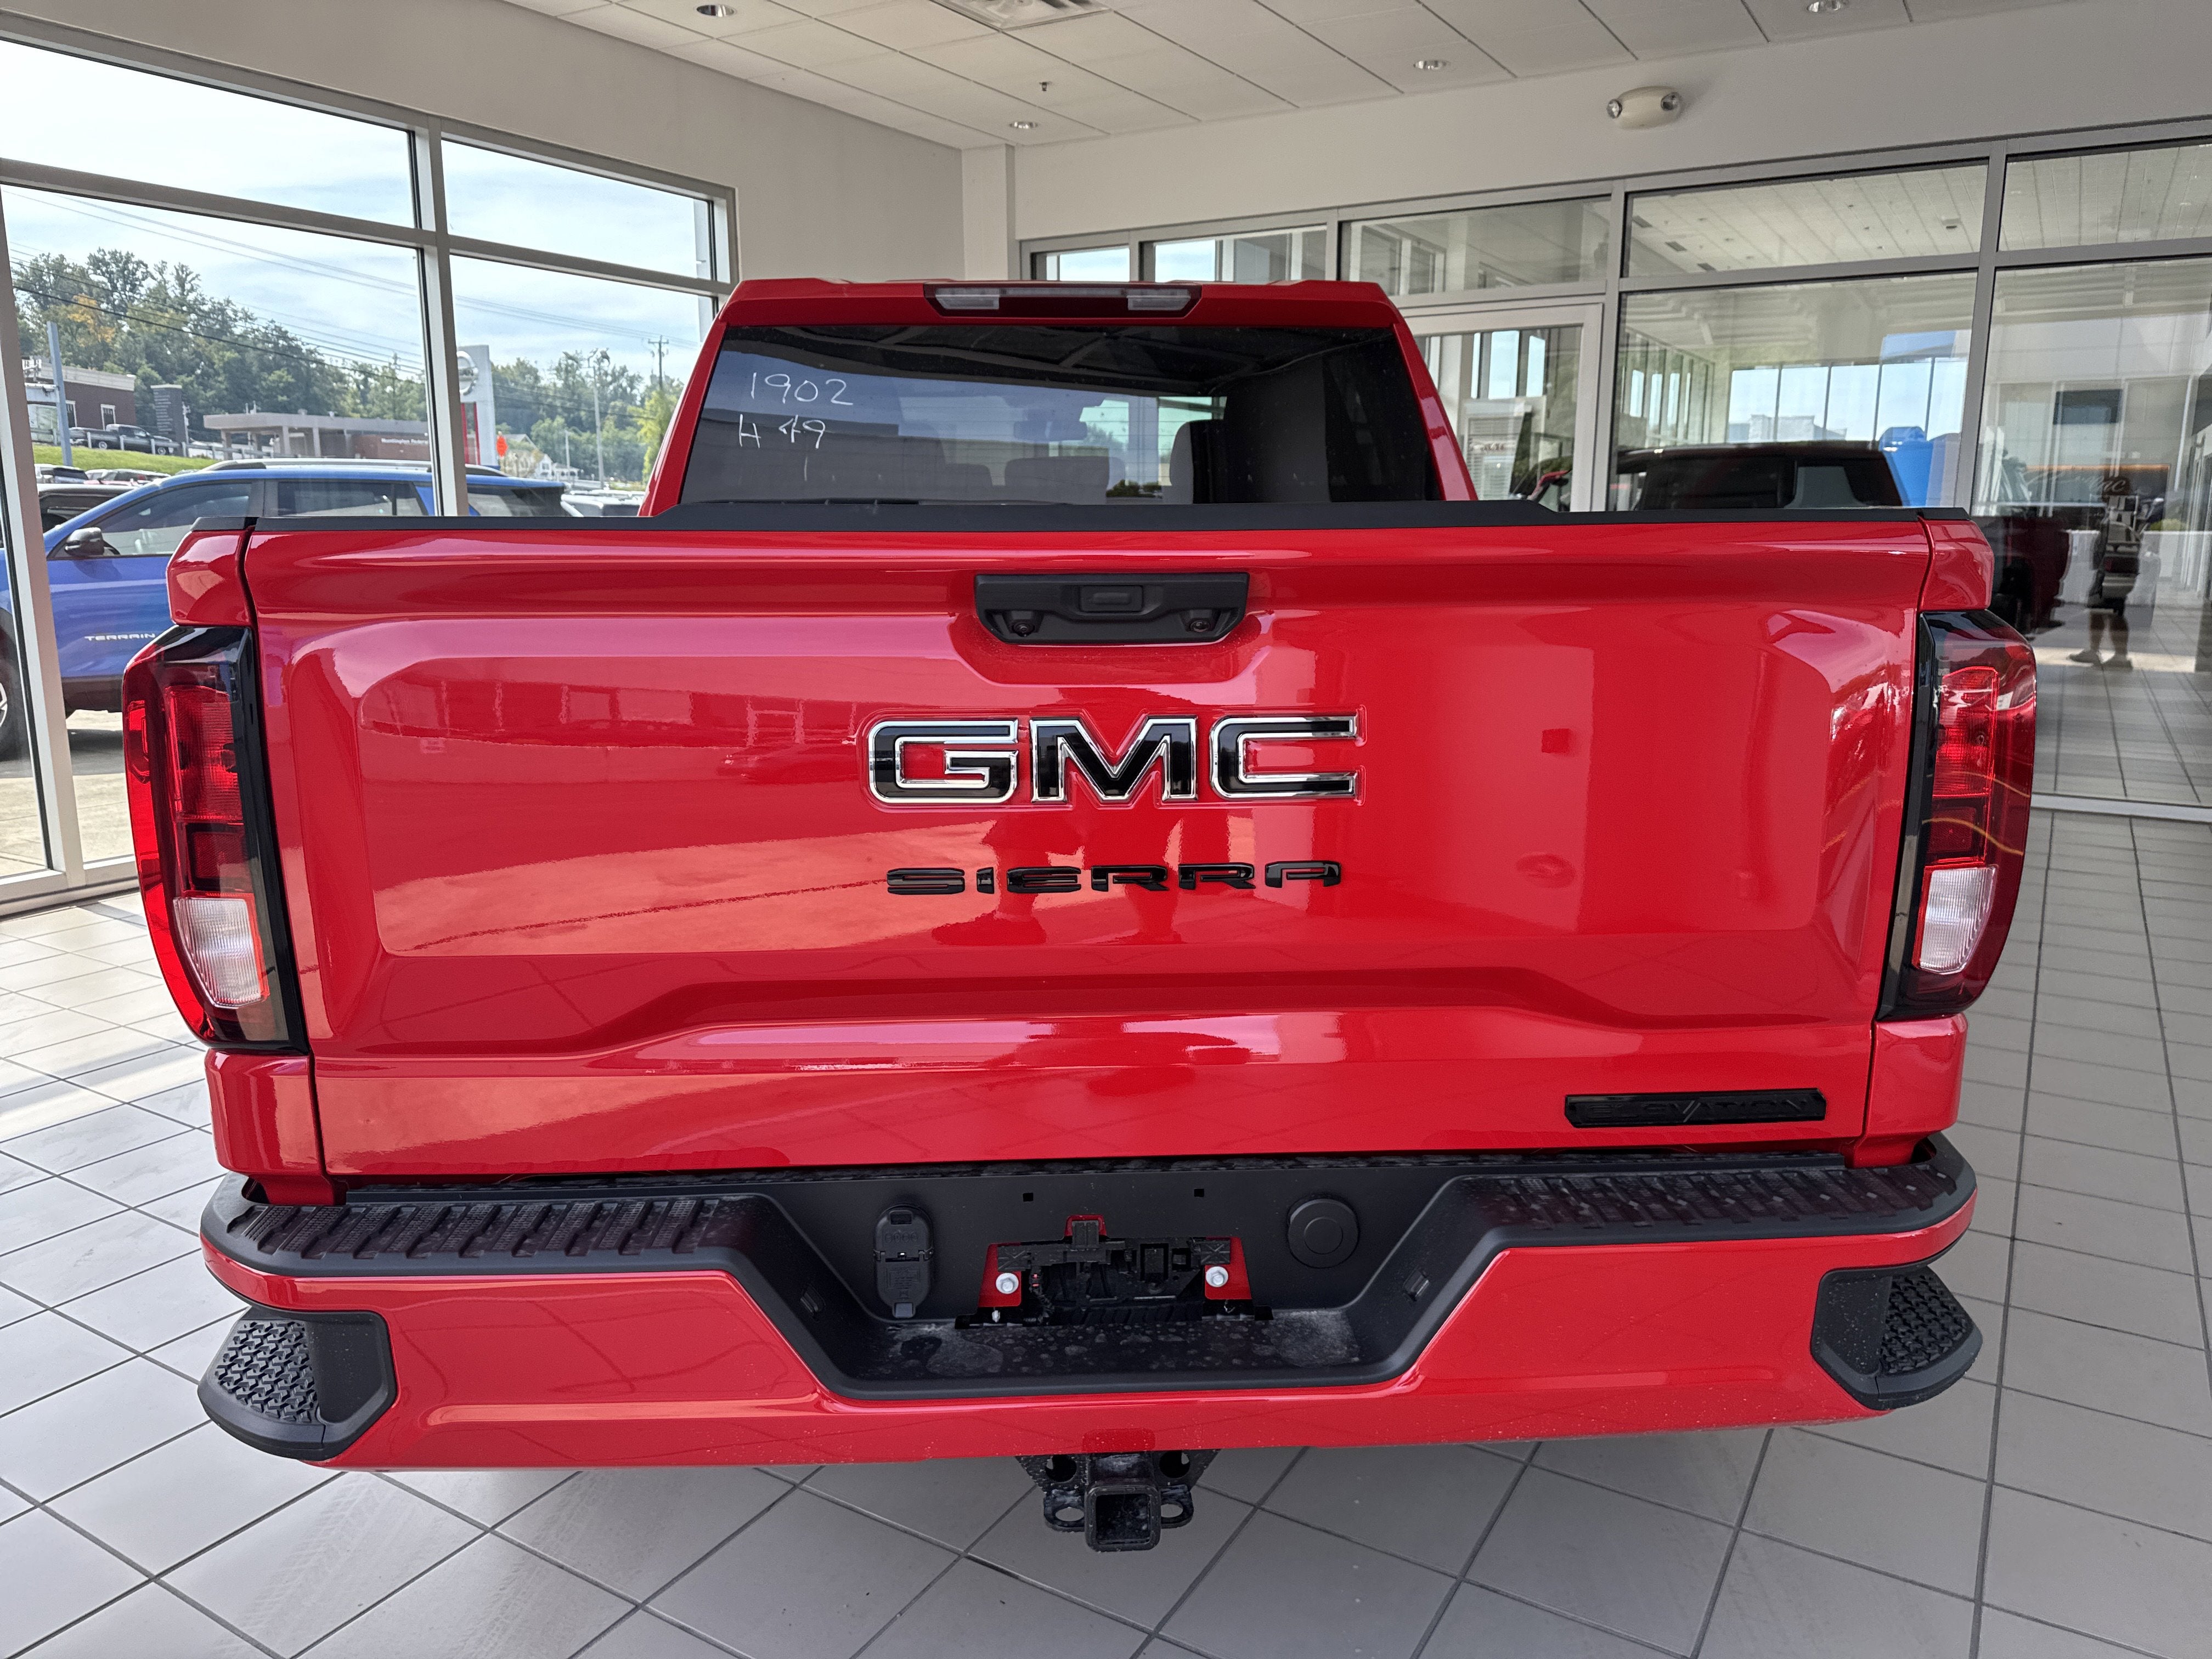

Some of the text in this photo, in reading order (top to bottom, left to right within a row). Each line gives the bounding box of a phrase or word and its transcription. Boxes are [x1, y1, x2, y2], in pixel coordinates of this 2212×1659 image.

[750, 372, 854, 405] 1902
[738, 414, 826, 449] H 49
[868, 715, 1358, 804] GMC
[886, 861, 1342, 895] SIERRA
